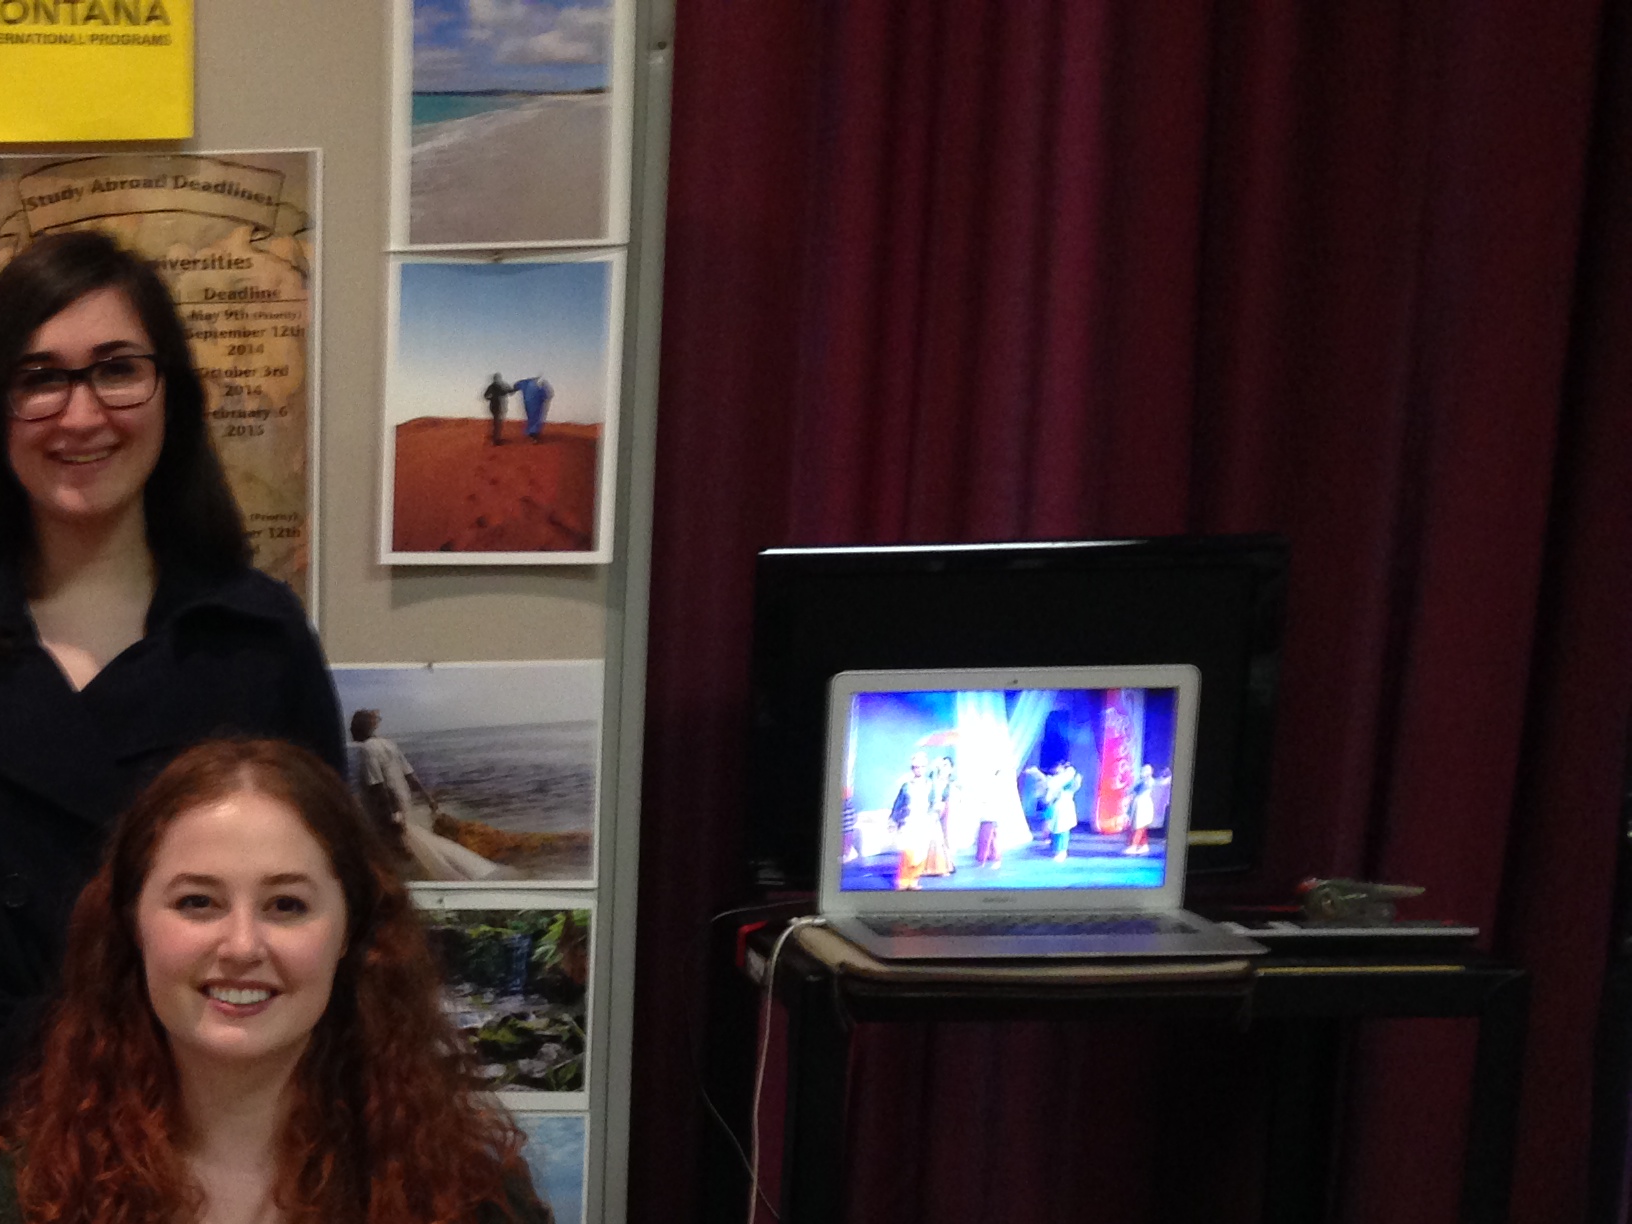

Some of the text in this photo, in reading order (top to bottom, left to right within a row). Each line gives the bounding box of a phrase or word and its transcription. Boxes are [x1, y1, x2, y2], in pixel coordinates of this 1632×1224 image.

[90, 33, 173, 47] PROGRAMS
[25, 173, 279, 212] Study Abroad Deadlines
[157, 250, 255, 271] iversities
[203, 286, 282, 301] Deadline
[272, 324, 306, 338] 12th
[227, 343, 265, 357] 2014
[263, 365, 290, 377] 3rd
